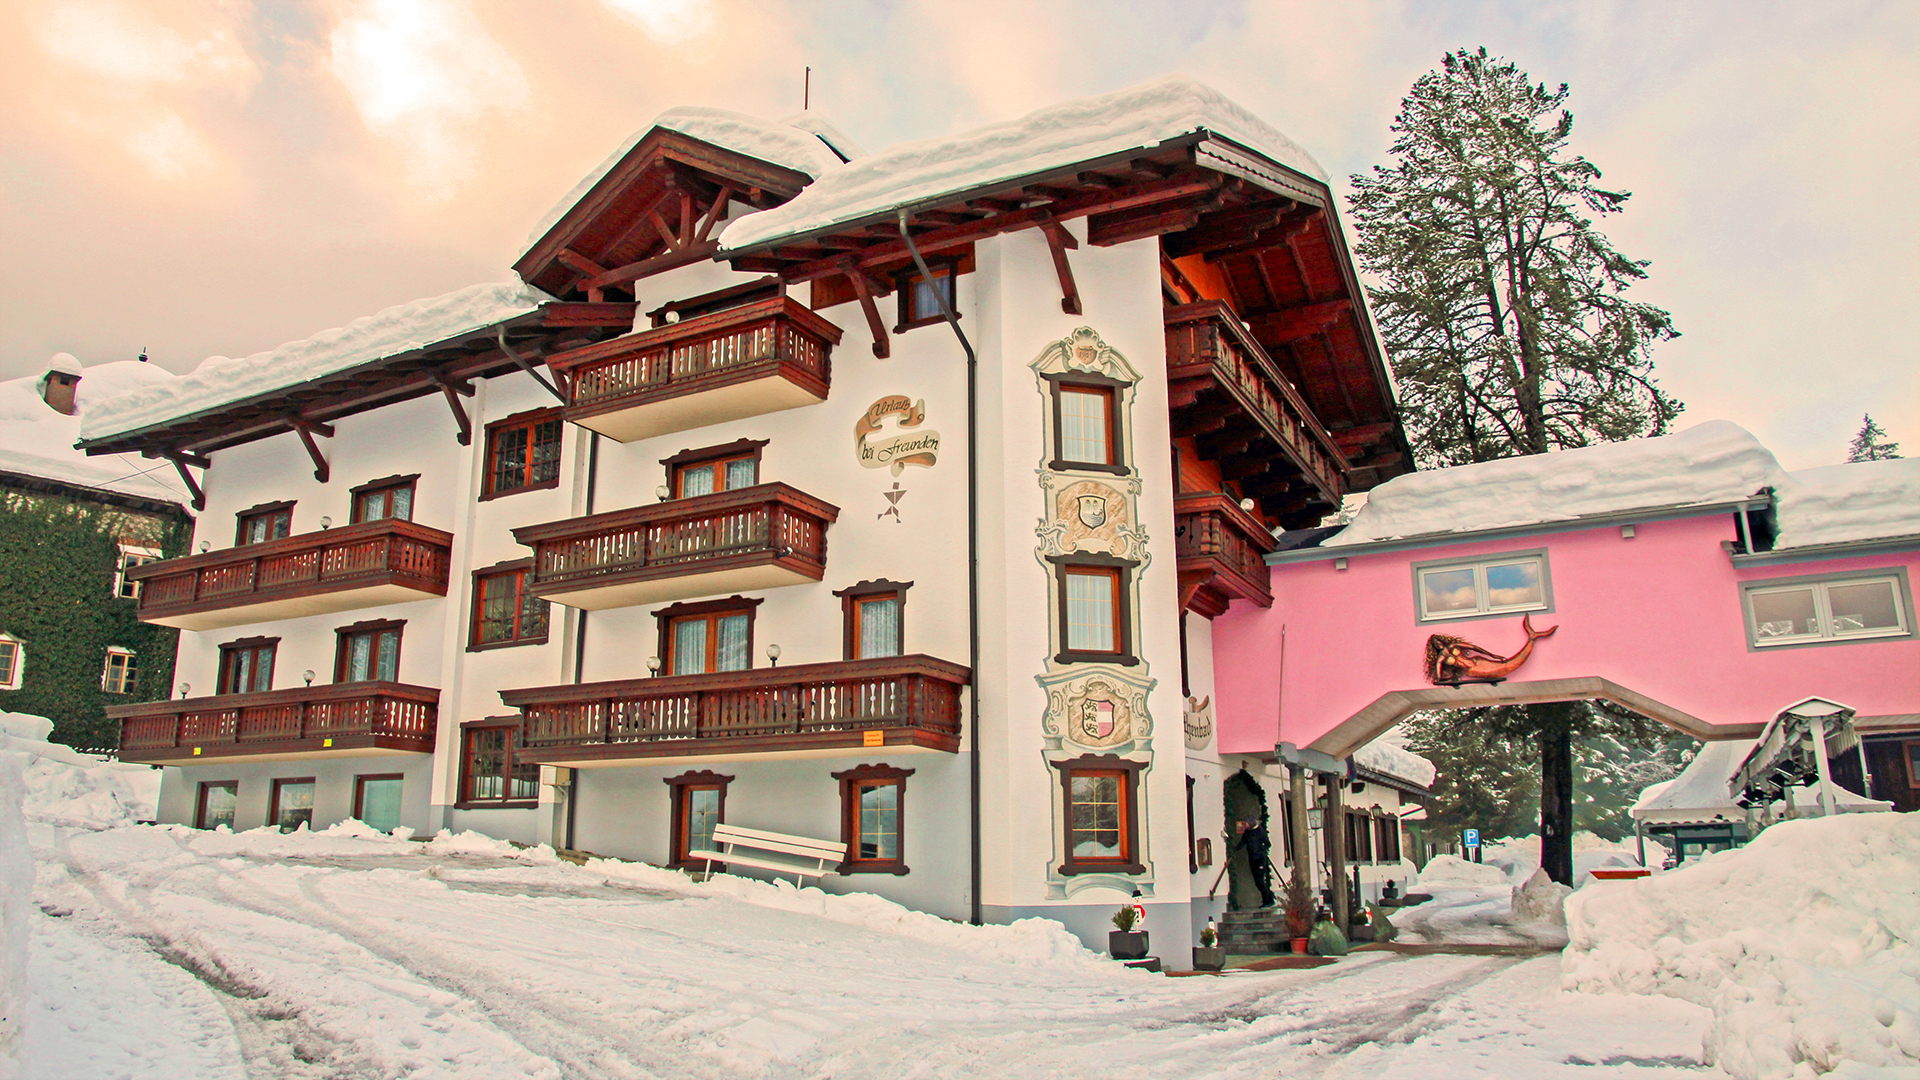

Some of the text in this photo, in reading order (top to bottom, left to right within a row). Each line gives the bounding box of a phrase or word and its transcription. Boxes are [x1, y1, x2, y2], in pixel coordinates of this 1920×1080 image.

[870, 399, 910, 416] Urlaub
[862, 435, 939, 462] bei Freunden
[1466, 831, 1477, 843] P
